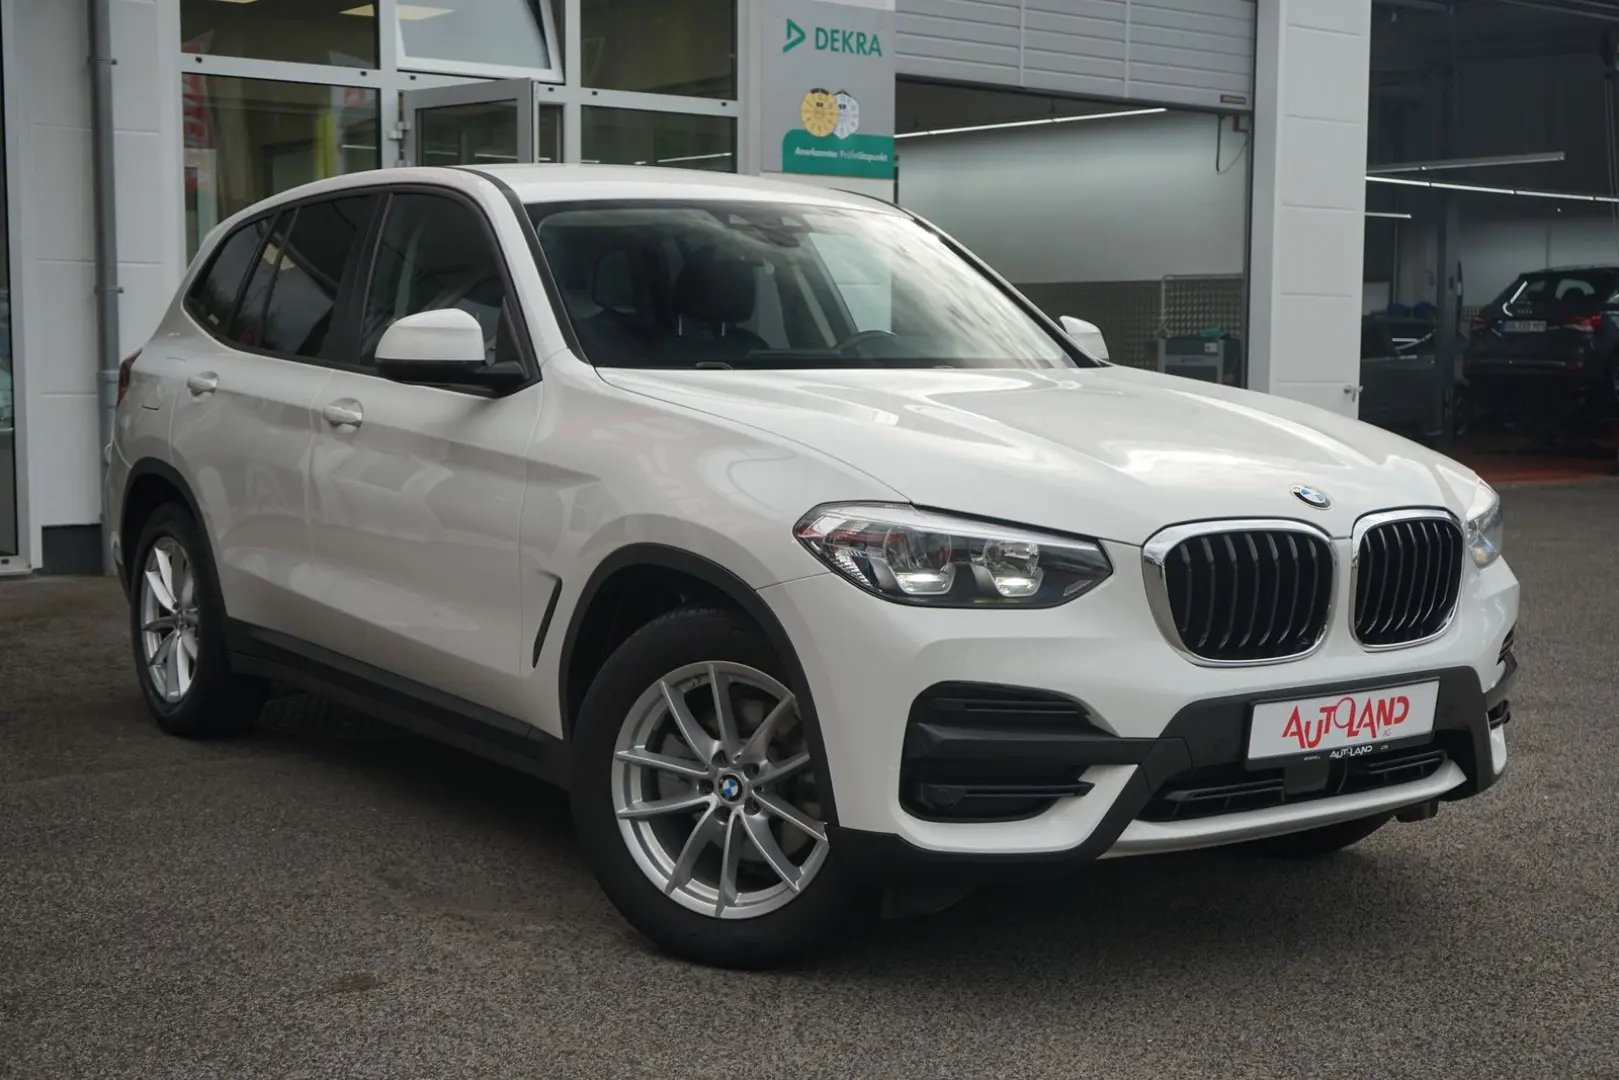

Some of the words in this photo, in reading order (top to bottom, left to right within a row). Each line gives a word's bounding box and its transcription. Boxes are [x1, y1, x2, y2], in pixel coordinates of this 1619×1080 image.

[815, 27, 881, 56] DEKRA
[1281, 696, 1409, 749] AUTOLAND
[1329, 745, 1373, 758] AUTOLAND
